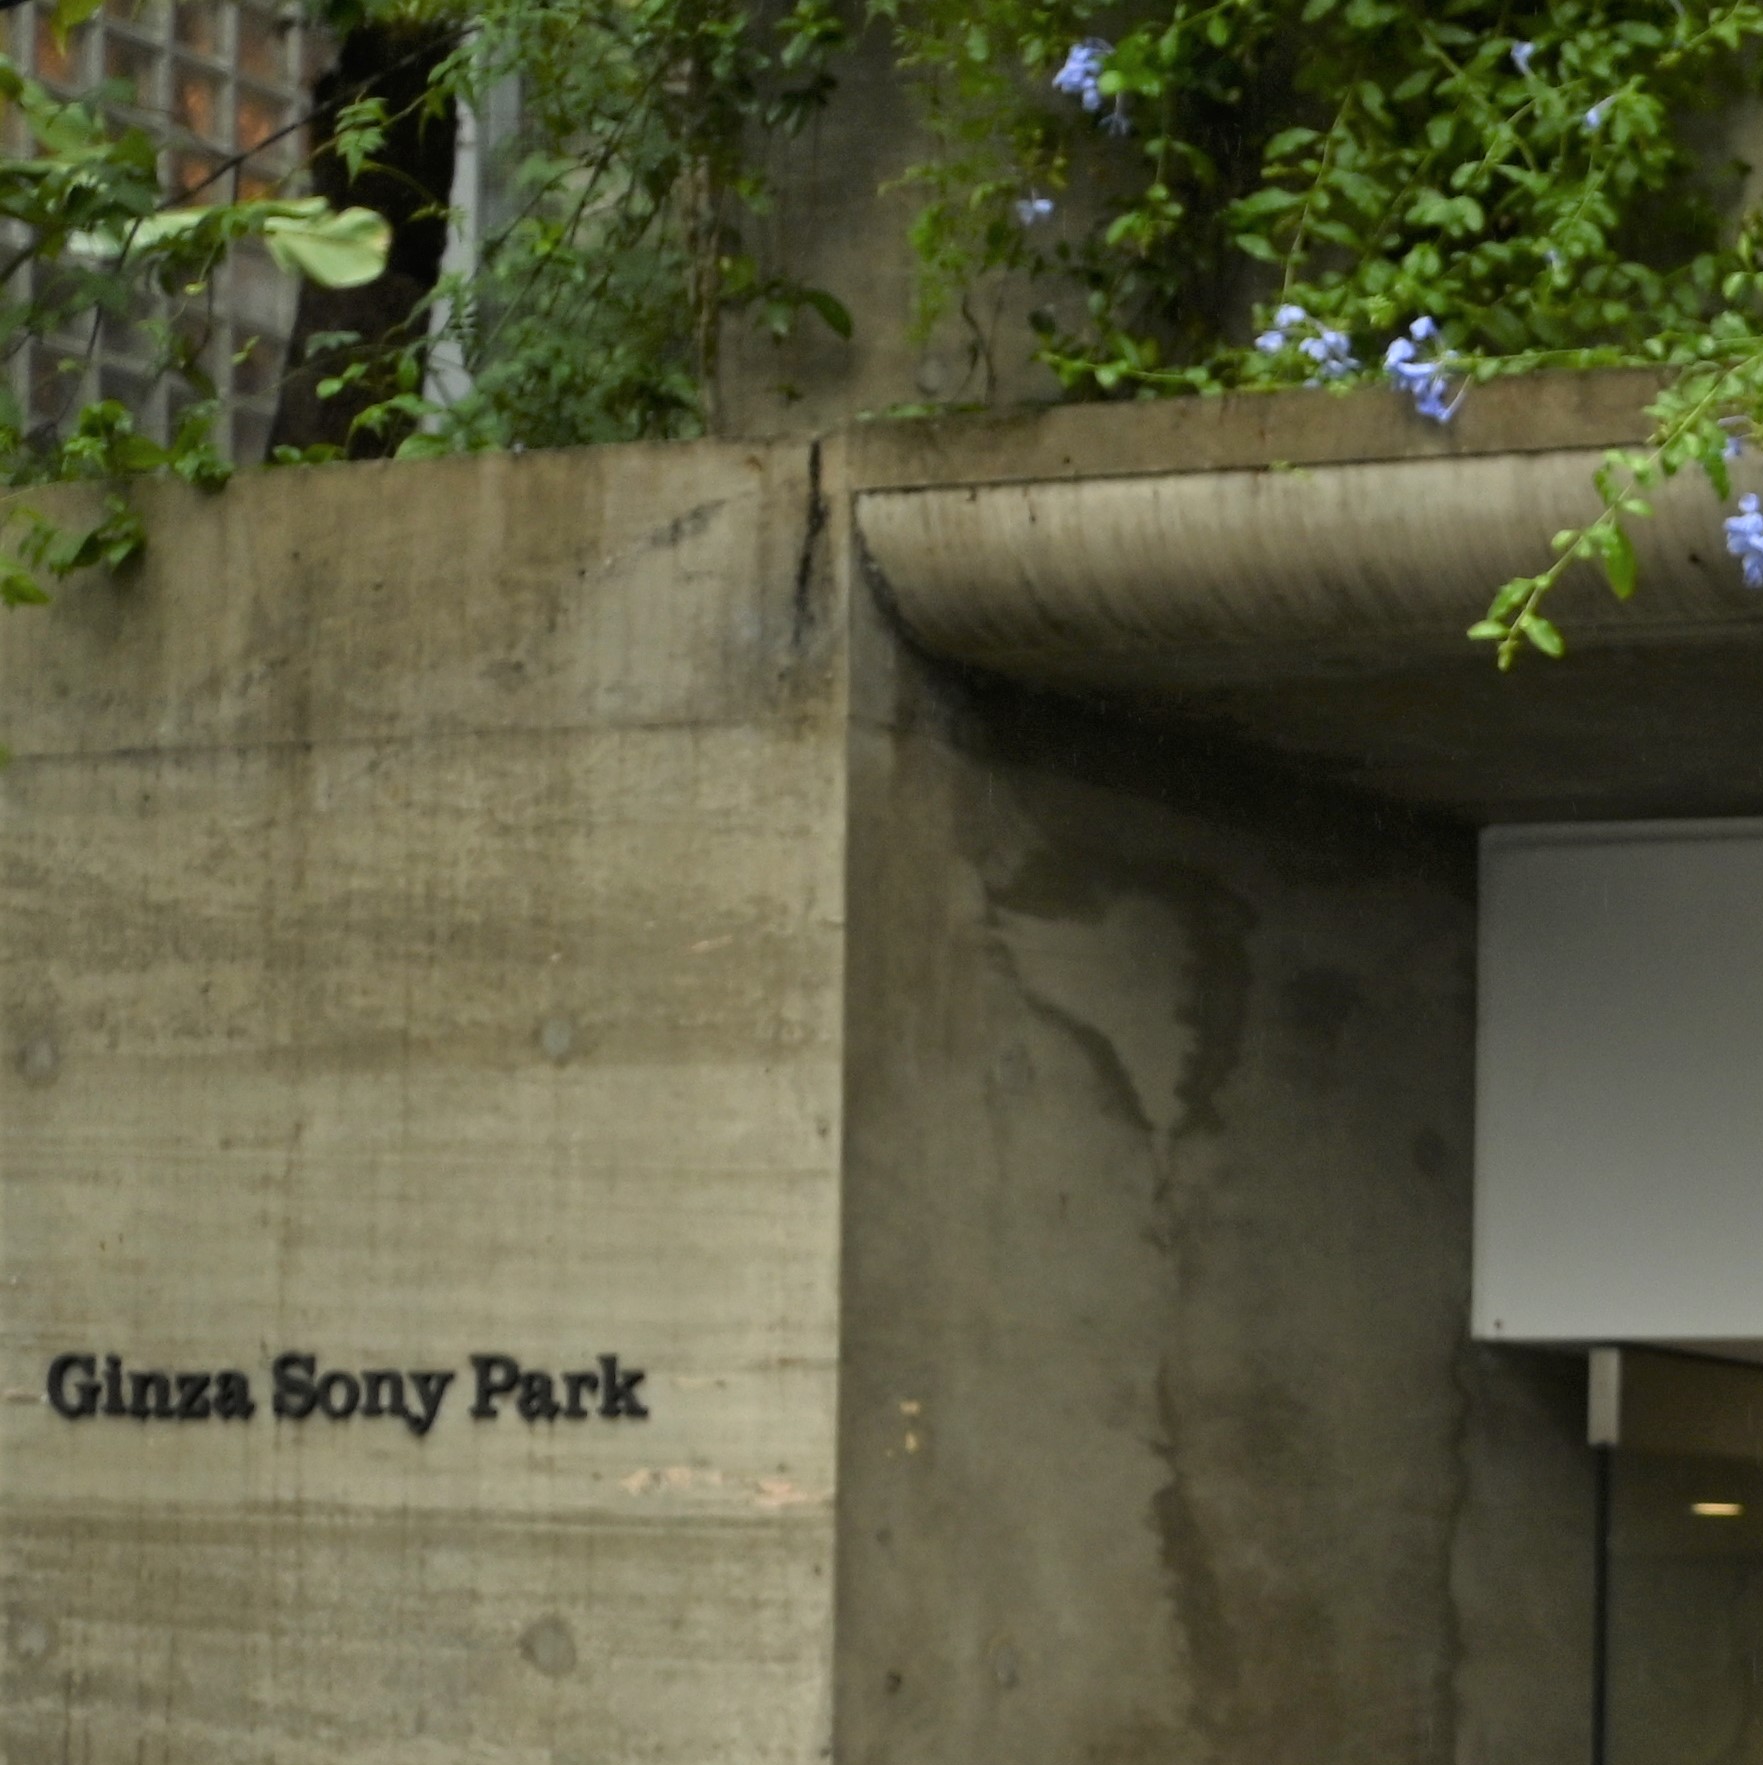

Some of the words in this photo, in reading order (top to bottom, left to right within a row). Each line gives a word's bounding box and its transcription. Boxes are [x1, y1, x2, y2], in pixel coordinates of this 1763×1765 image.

[46, 1352, 256, 1420] Ginza
[271, 1352, 455, 1438] Sony
[470, 1352, 649, 1420] Park
